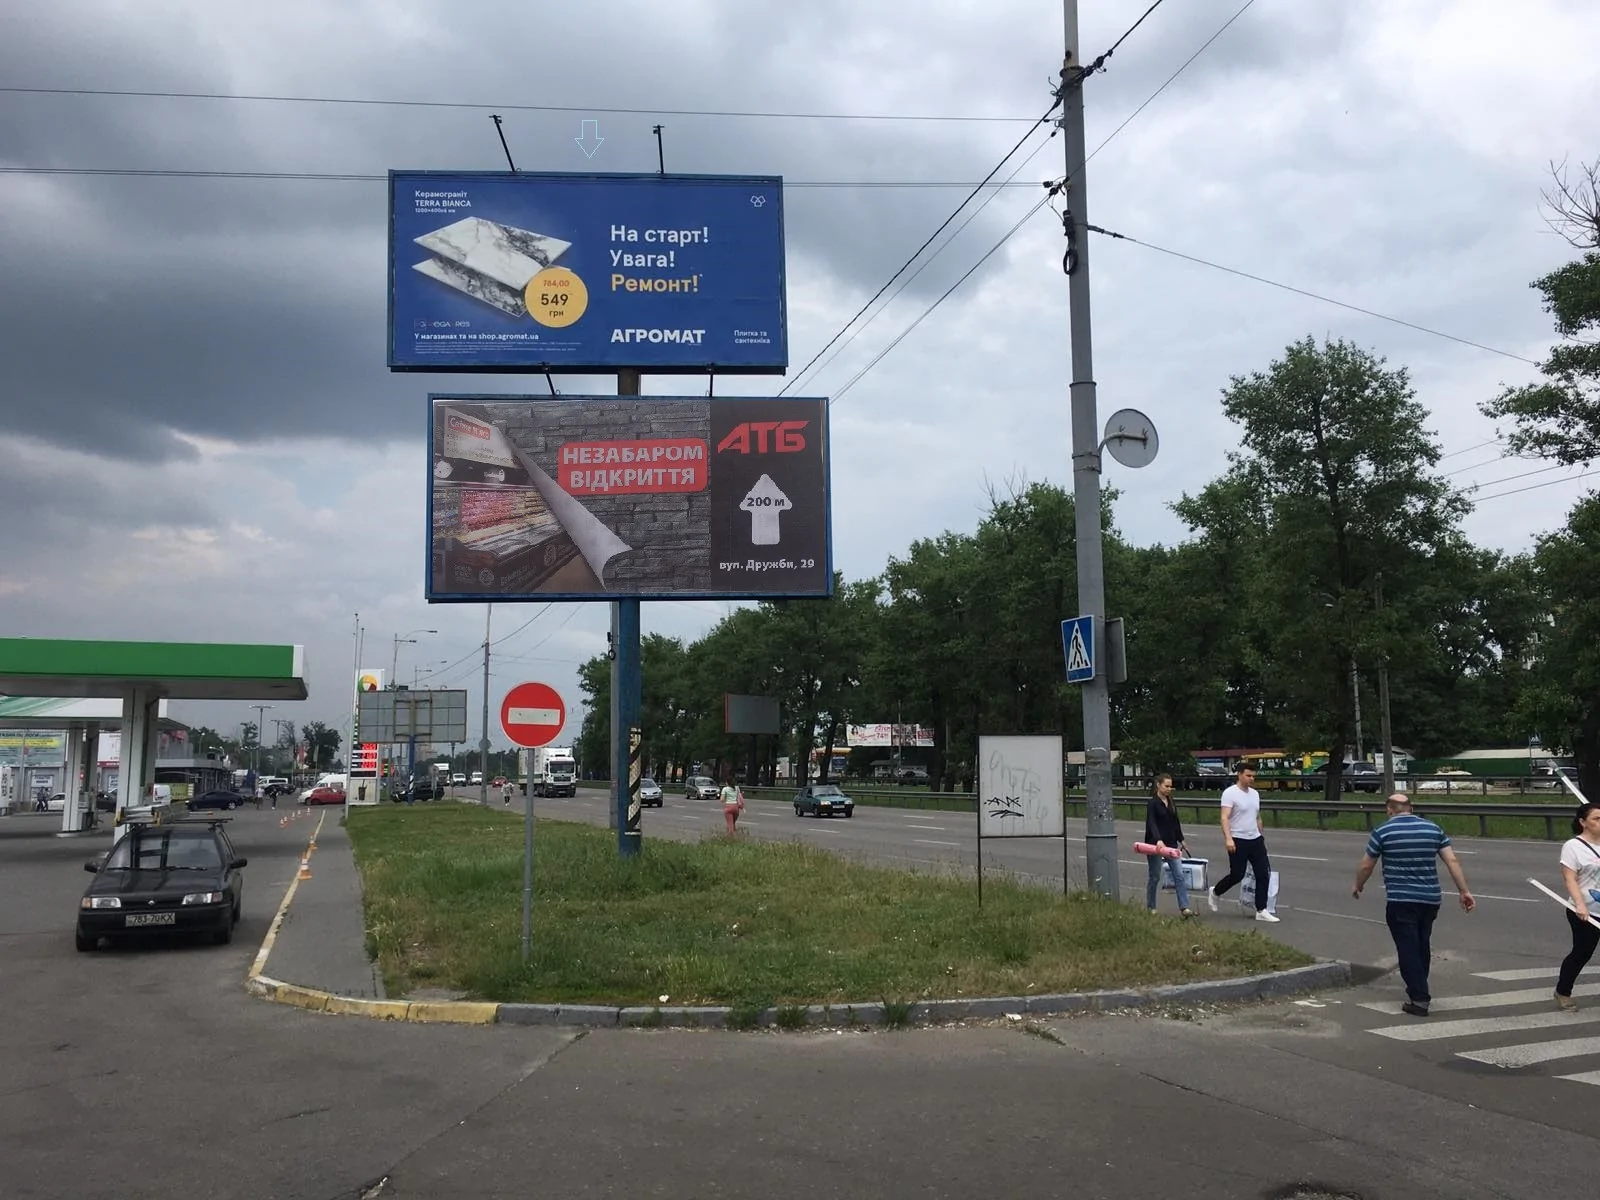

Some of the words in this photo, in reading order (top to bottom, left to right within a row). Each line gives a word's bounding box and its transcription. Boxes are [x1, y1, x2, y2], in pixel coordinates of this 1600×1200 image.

[415, 190, 468, 199] Керамограніт
[610, 224, 638, 242] На
[644, 227, 709, 247] старт!
[609, 249, 675, 268] Увага!
[543, 279, 570, 288] 784,00
[541, 293, 569, 306] 549
[549, 310, 564, 318] грн
[478, 333, 539, 341] shop.agromat.ua
[610, 328, 706, 344] АГРОМАТ
[717, 420, 811, 454] АТБ
[562, 444, 704, 464] НЕЗАБАРОМ
[570, 467, 695, 492] ВІДКРИТТЯ
[746, 496, 772, 507] 200
[774, 498, 785, 507] м
[719, 561, 745, 571] вул.
[745, 558, 796, 573] Дружби,
[800, 558, 815, 569] 29
